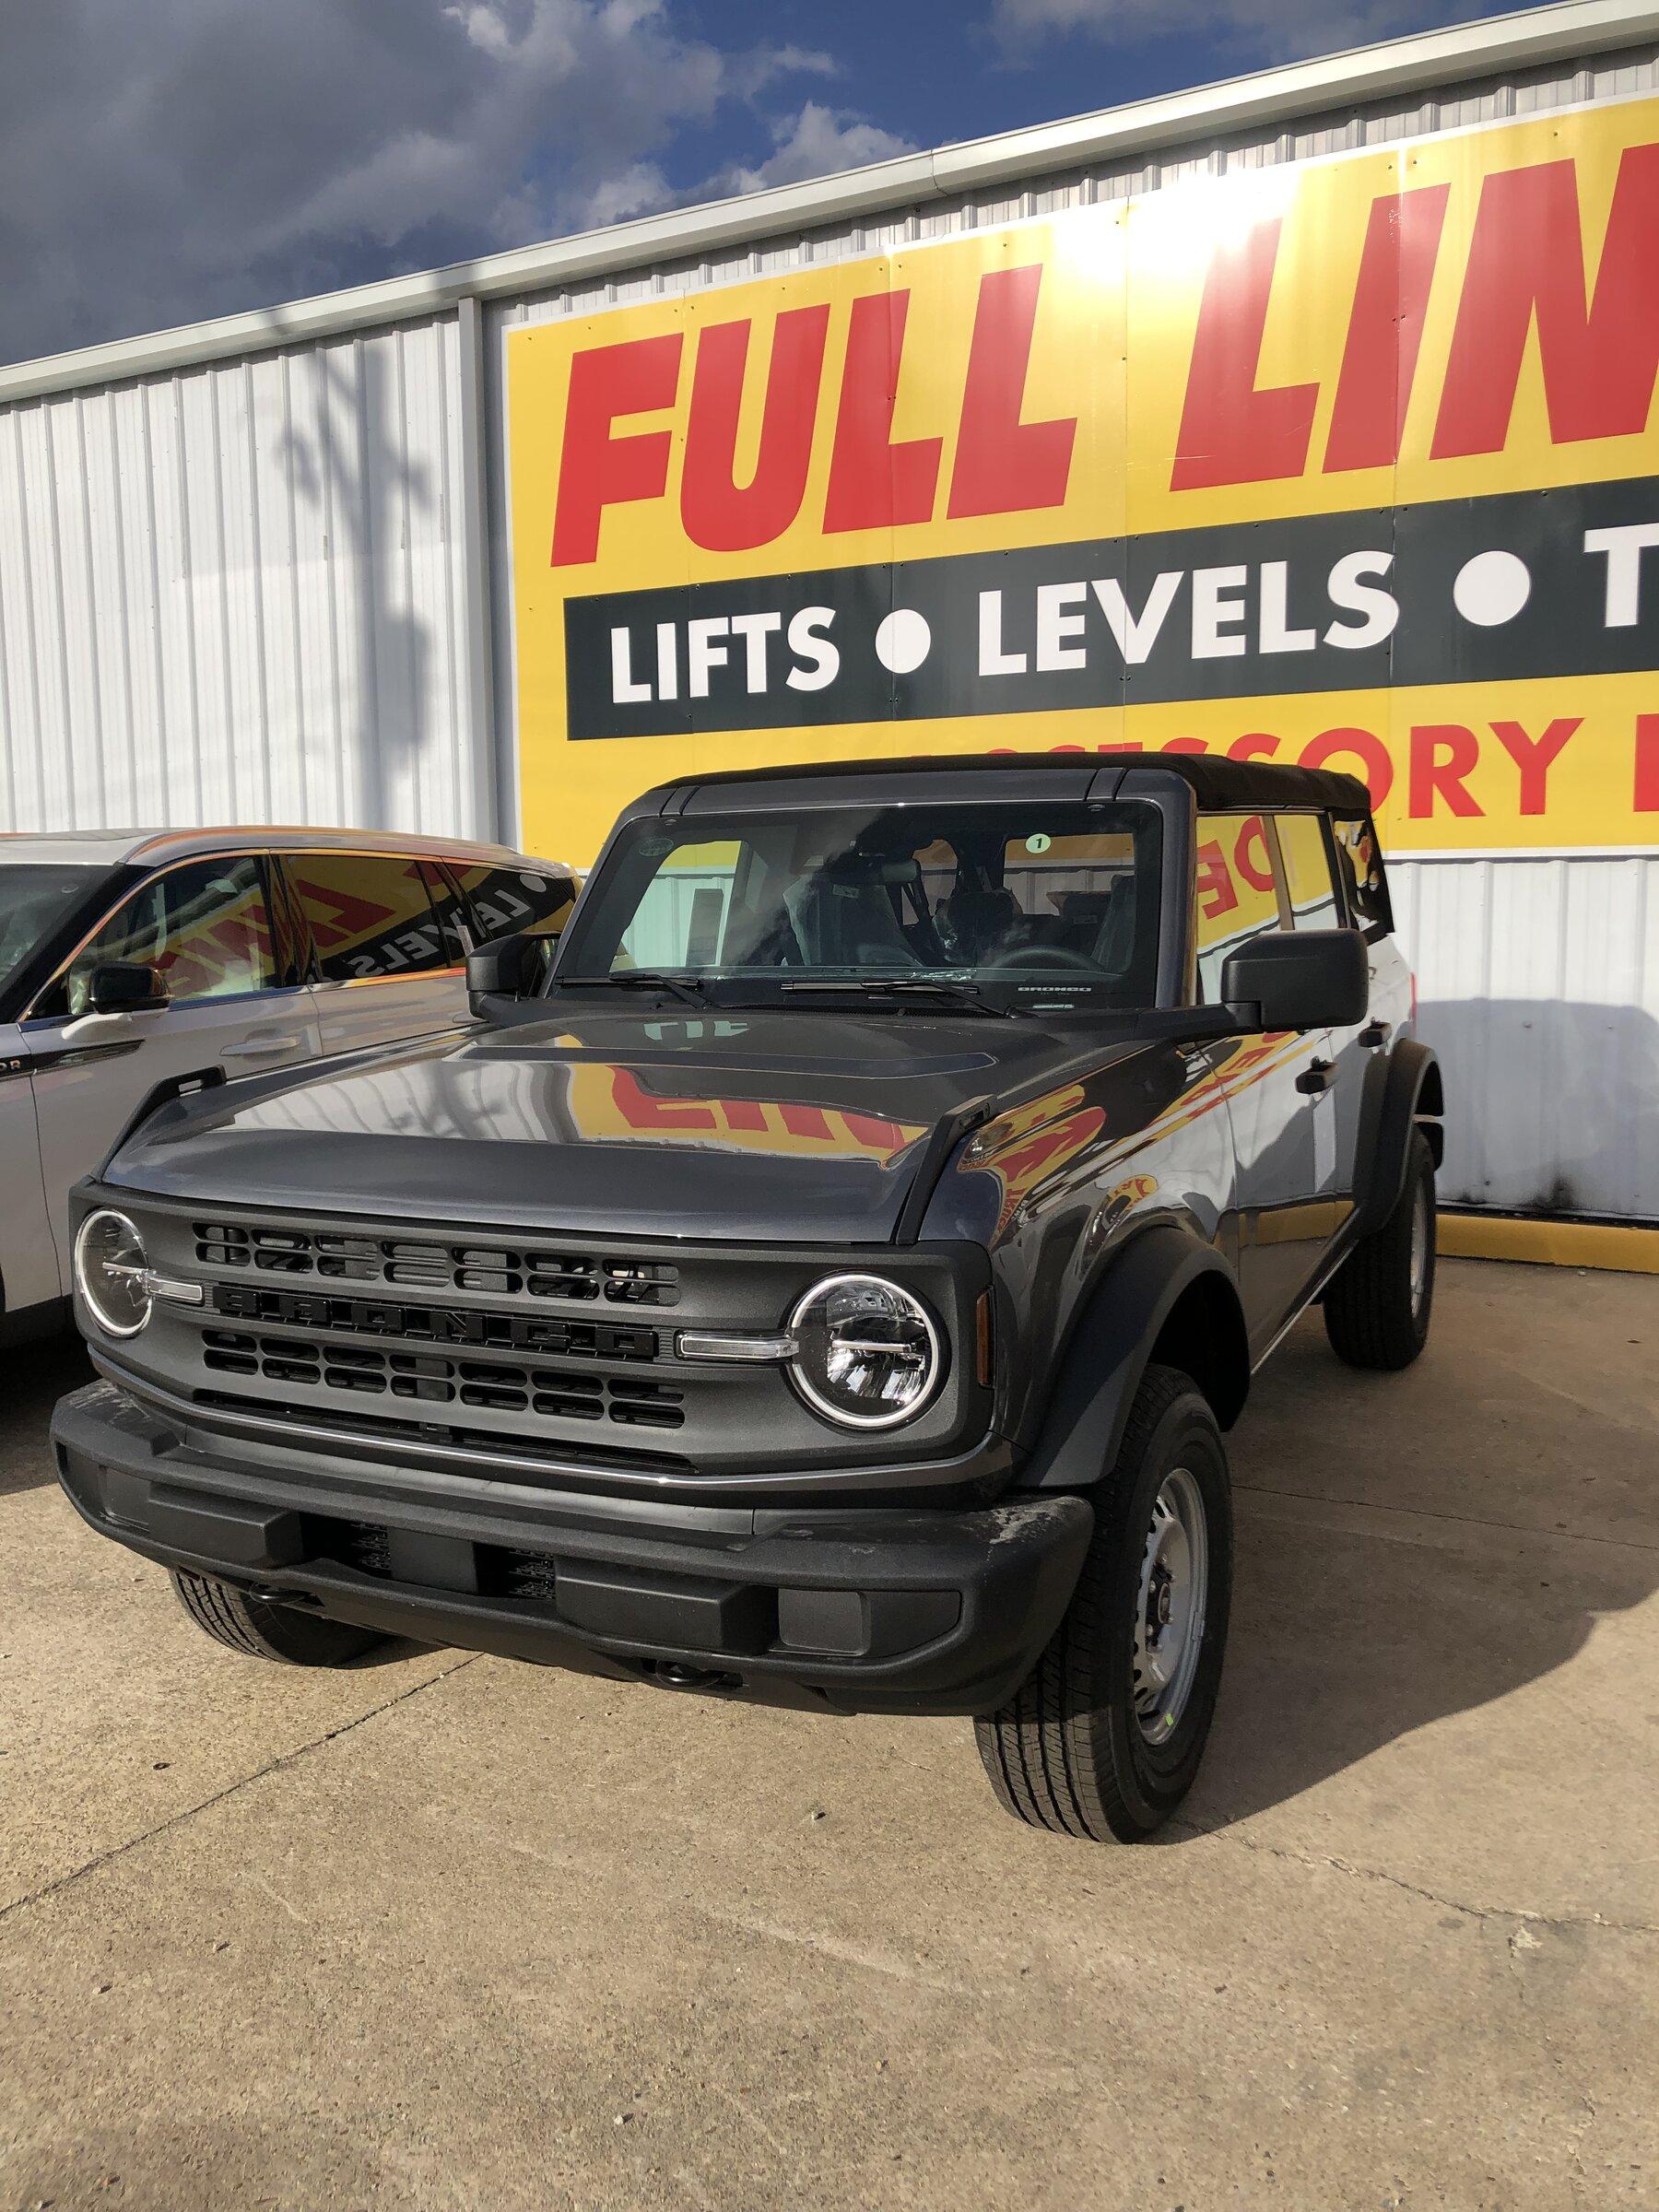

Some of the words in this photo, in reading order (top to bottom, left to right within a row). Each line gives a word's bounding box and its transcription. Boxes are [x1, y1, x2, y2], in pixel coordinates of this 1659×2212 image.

[550, 264, 1077, 568] FULL
[610, 606, 842, 704] LIFTS
[977, 550, 1400, 677] LEVELS
[1583, 523, 1659, 629] T
[212, 1286, 658, 1359] BRONCO
